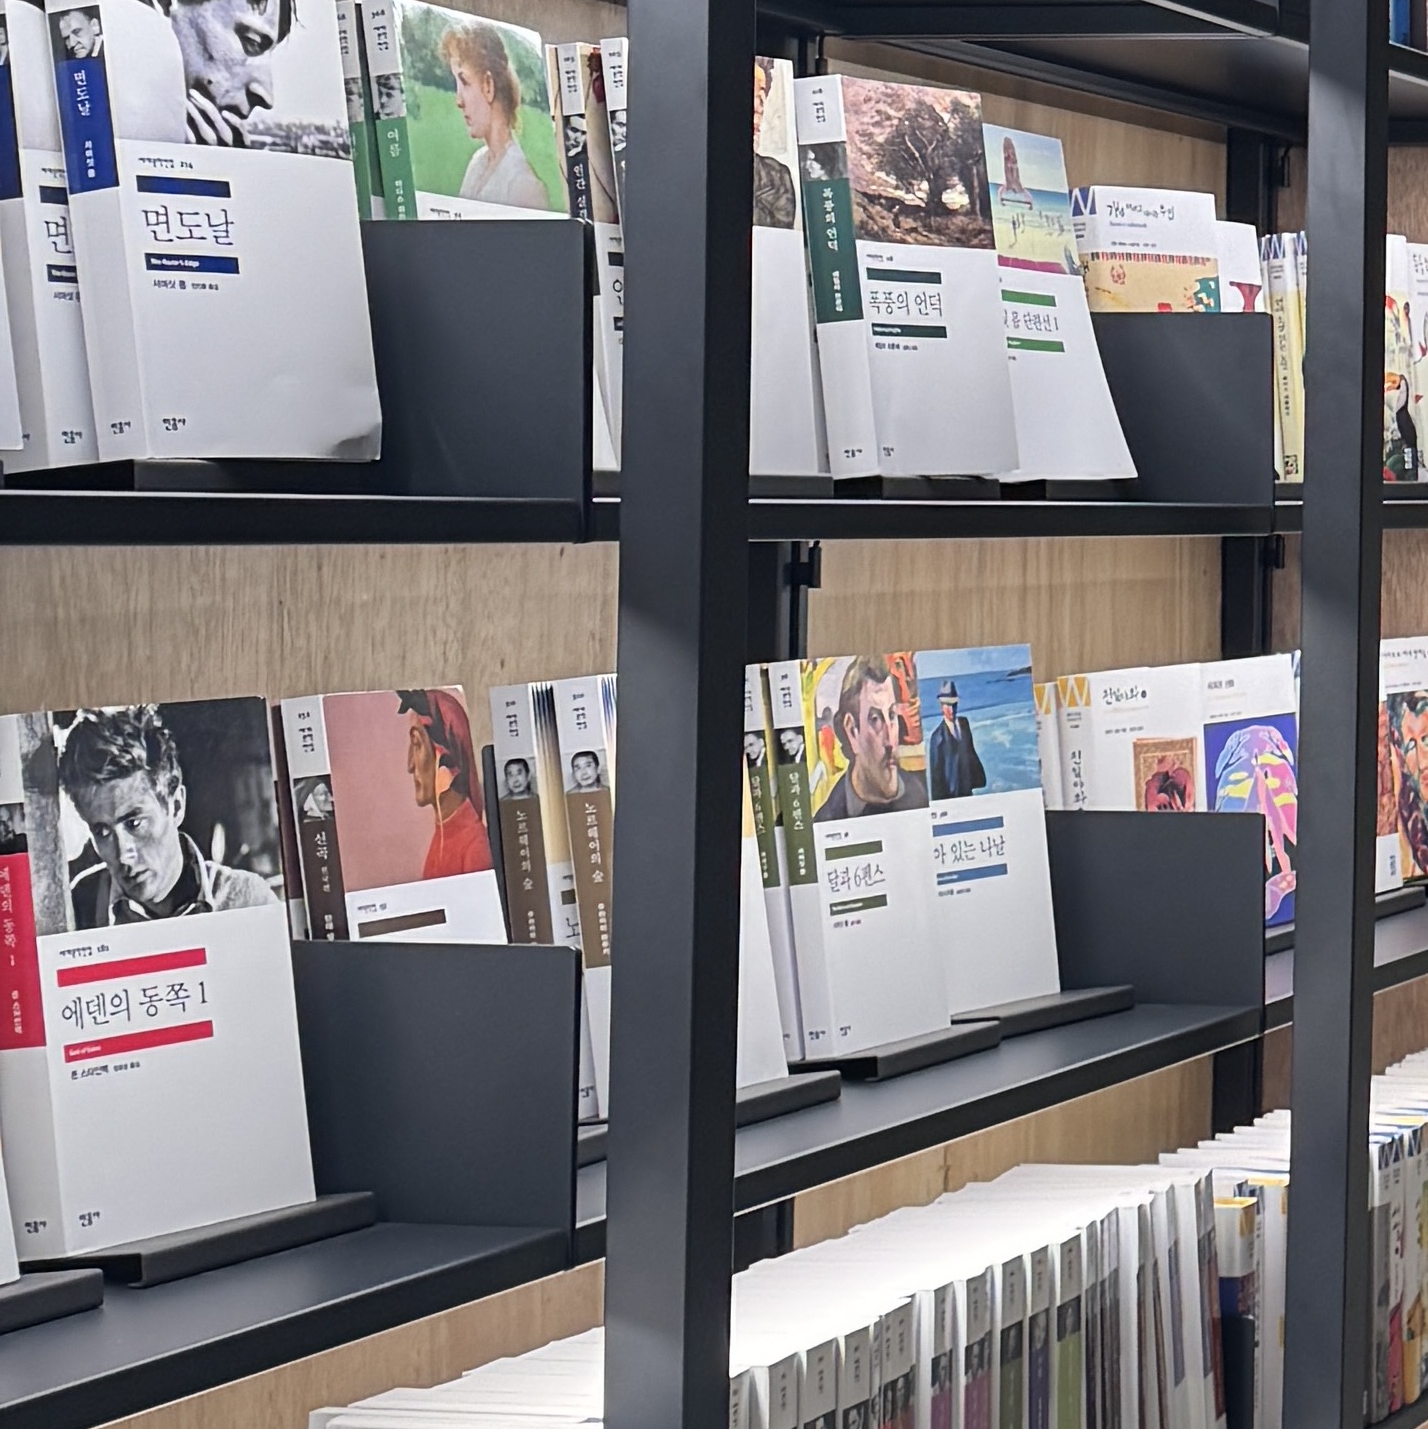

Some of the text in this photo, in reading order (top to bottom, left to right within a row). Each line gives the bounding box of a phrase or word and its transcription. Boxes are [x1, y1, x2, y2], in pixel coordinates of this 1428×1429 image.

[74, 68, 92, 117] 면도날
[44, 217, 72, 254] 면
[141, 204, 235, 248] 면도날
[869, 291, 943, 318] 폭풍의 언덕
[516, 810, 532, 873] 노르웨이의
[584, 802, 602, 866] 노르웨이의
[951, 839, 977, 864] 있는
[980, 835, 1007, 859] 나날
[592, 870, 605, 885] 숲
[827, 861, 887, 893] 달과 6펜스
[61, 978, 209, 1030] 에덴의 동쪽 1
